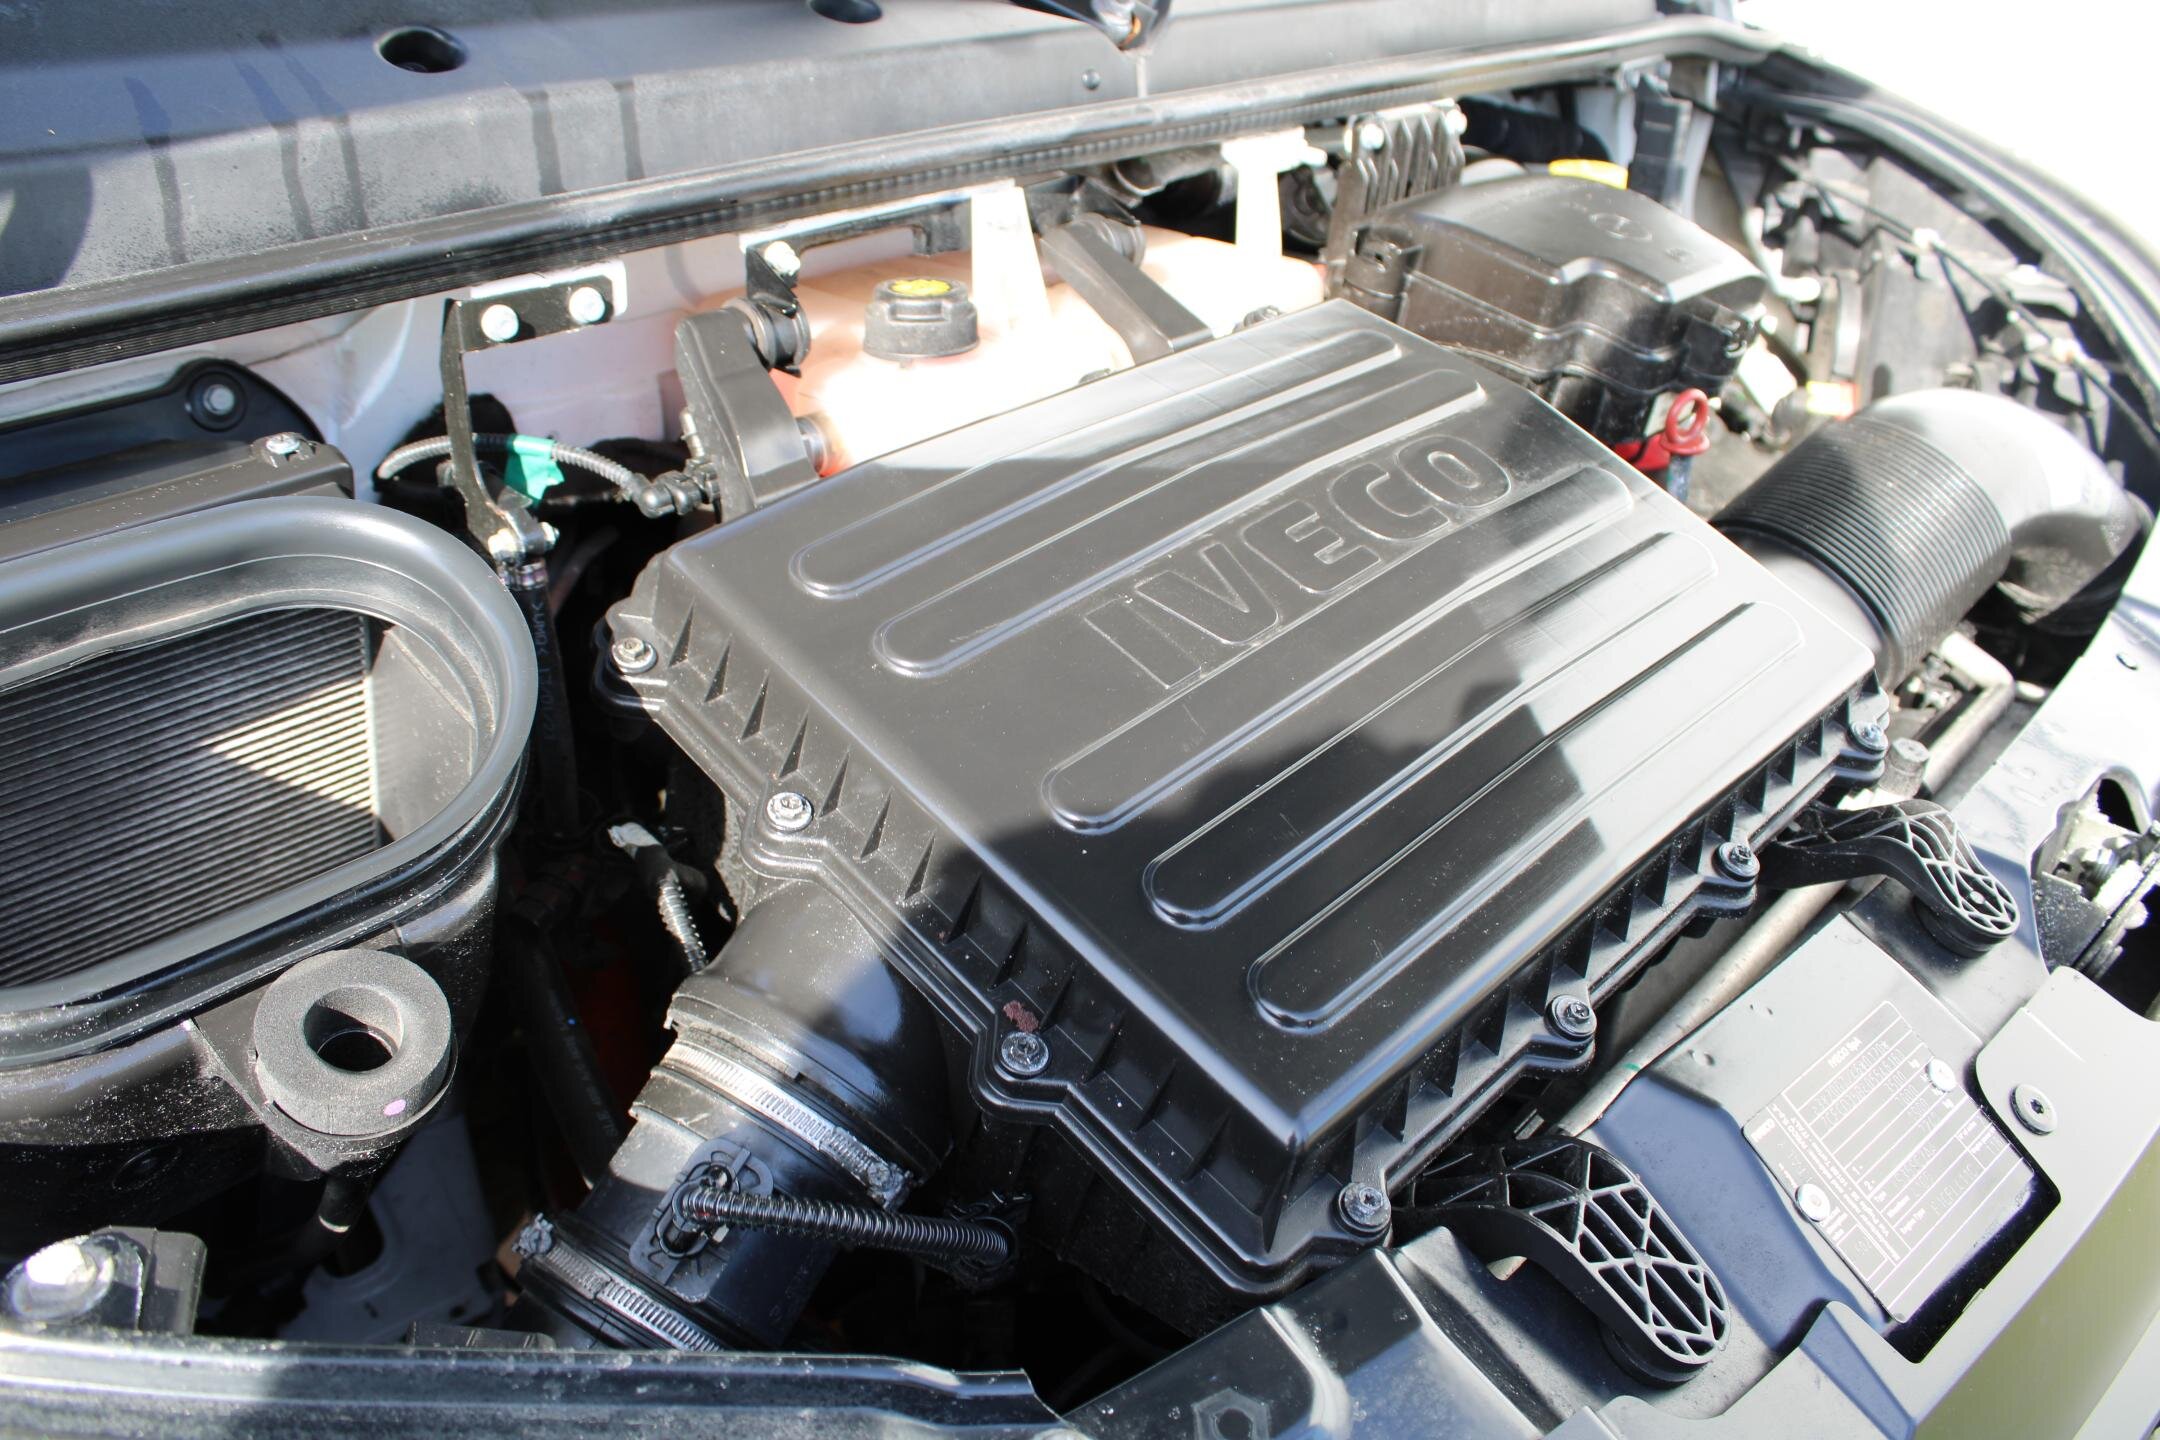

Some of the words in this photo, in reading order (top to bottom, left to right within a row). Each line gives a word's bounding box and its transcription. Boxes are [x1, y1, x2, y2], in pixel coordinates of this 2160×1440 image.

[1084, 434, 1511, 689] IVECO
[1786, 1124, 1809, 1150] IVECO
[1790, 1117, 1811, 1140] ITALY
